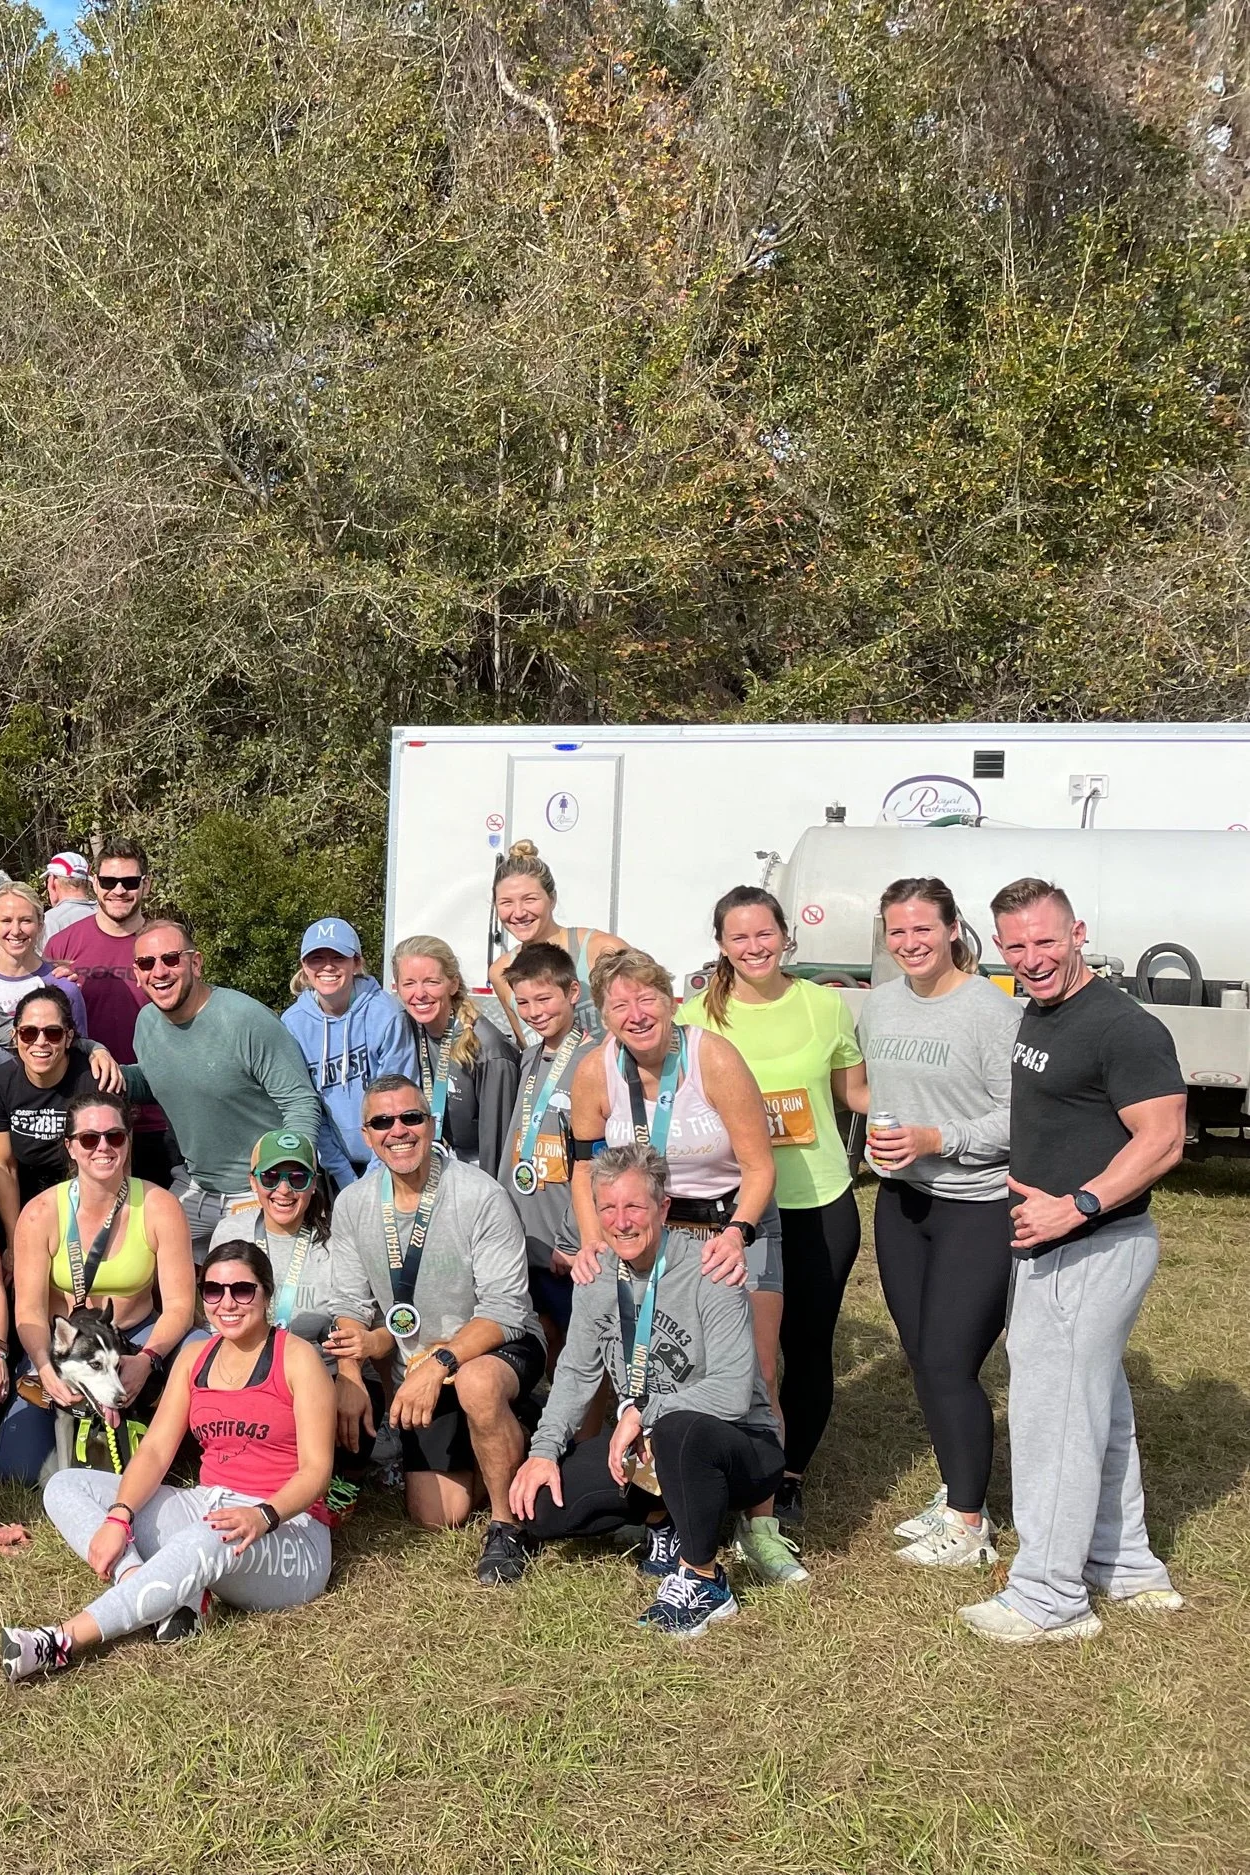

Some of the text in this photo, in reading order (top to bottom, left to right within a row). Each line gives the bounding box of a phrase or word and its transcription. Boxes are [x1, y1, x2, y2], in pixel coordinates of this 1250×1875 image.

[316, 923, 336, 940] M
[917, 1040, 951, 1068] RUN
[524, 1074, 537, 1096] 2022
[781, 1095, 804, 1113] RUN
[685, 1113, 722, 1138] THE
[382, 1202, 404, 1270] BUFFALO RUN
[409, 1224, 427, 1249] 2022
[68, 1240, 87, 1304] BUFFALO RUN
[295, 1286, 316, 1310] UN
[633, 1343, 649, 1367] RUN
